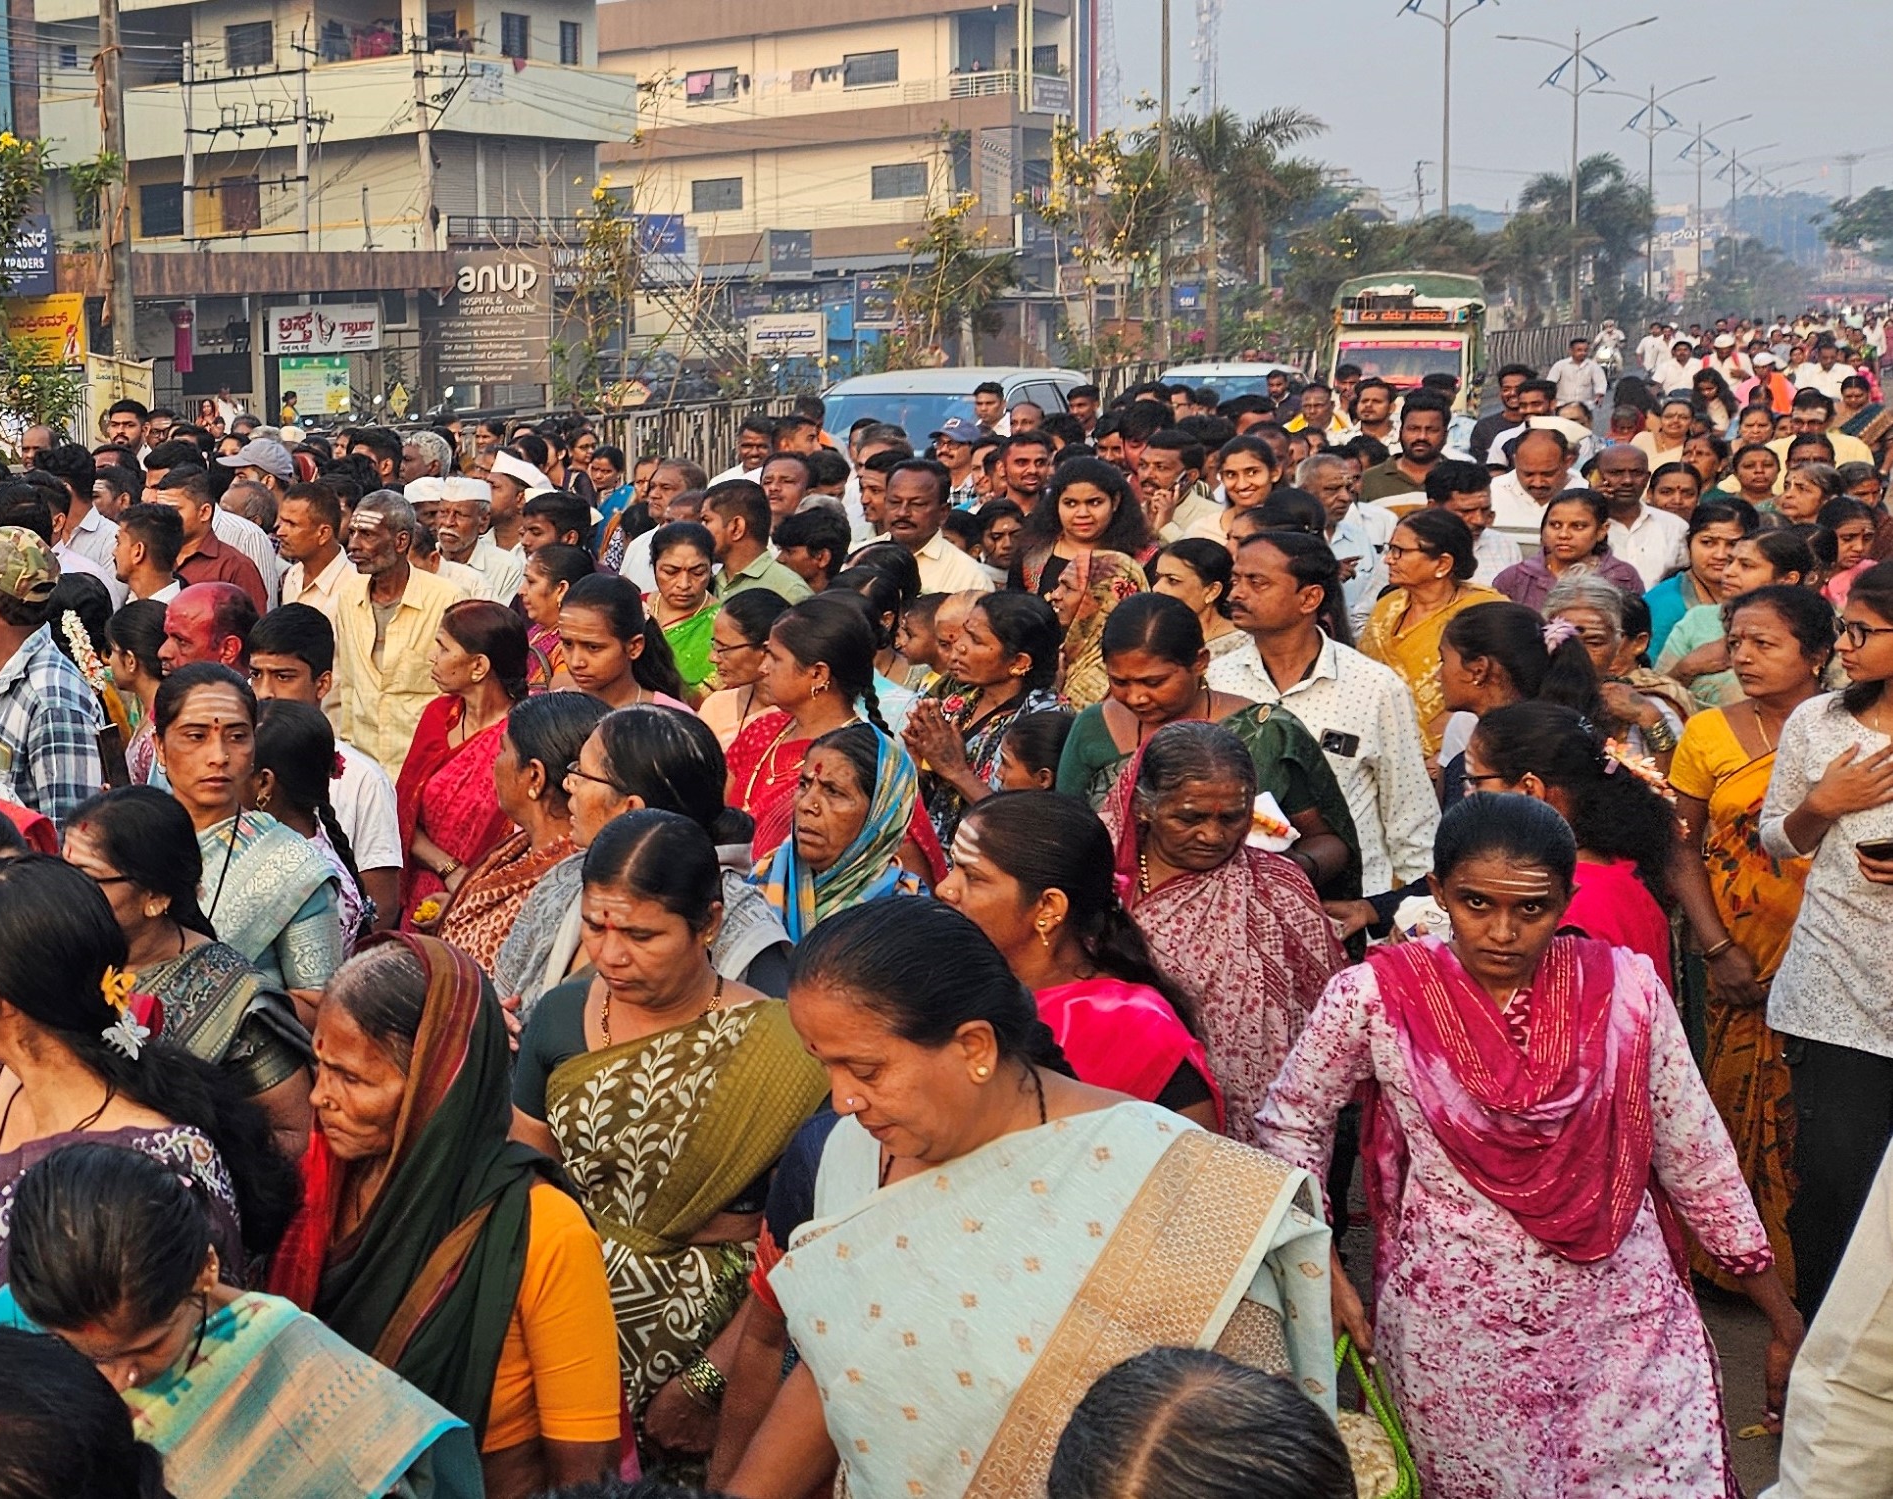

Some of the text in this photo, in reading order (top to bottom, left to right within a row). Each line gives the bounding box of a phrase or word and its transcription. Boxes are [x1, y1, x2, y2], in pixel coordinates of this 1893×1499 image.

[4, 257, 45, 269] TRADERS
[457, 263, 538, 299] anup
[459, 296, 494, 306] HOSPITAL
[459, 306, 484, 316] HEART
[485, 305, 505, 315] CARE
[338, 321, 375, 335] TRUST
